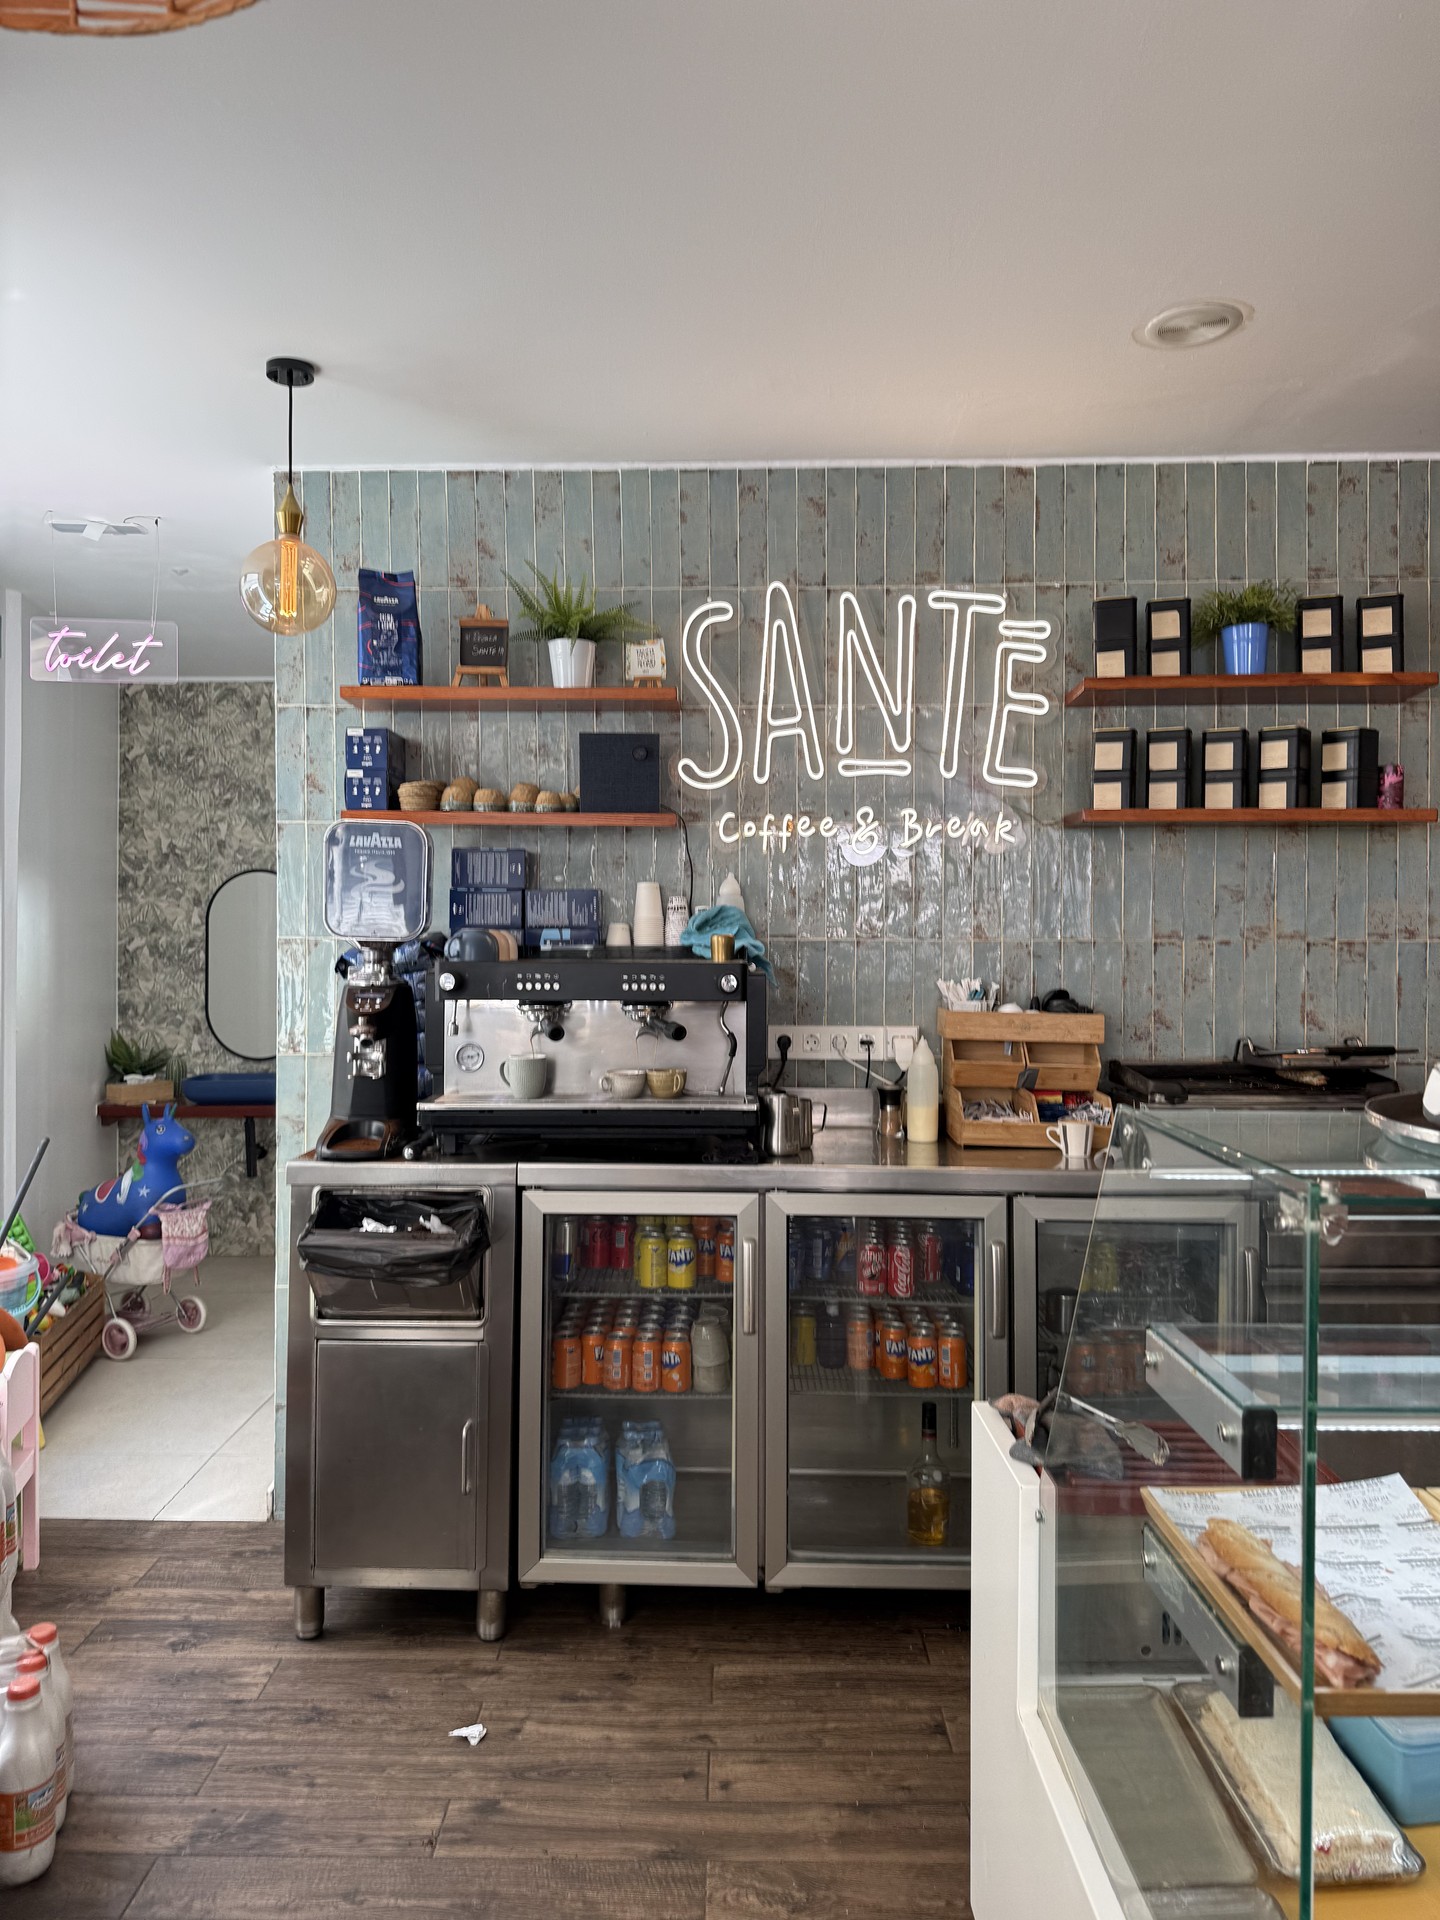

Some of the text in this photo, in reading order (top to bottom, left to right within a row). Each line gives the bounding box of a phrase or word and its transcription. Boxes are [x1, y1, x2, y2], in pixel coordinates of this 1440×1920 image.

[349, 831, 402, 849] LAVAZZA
[718, 806, 1016, 855] Coffee & Break
